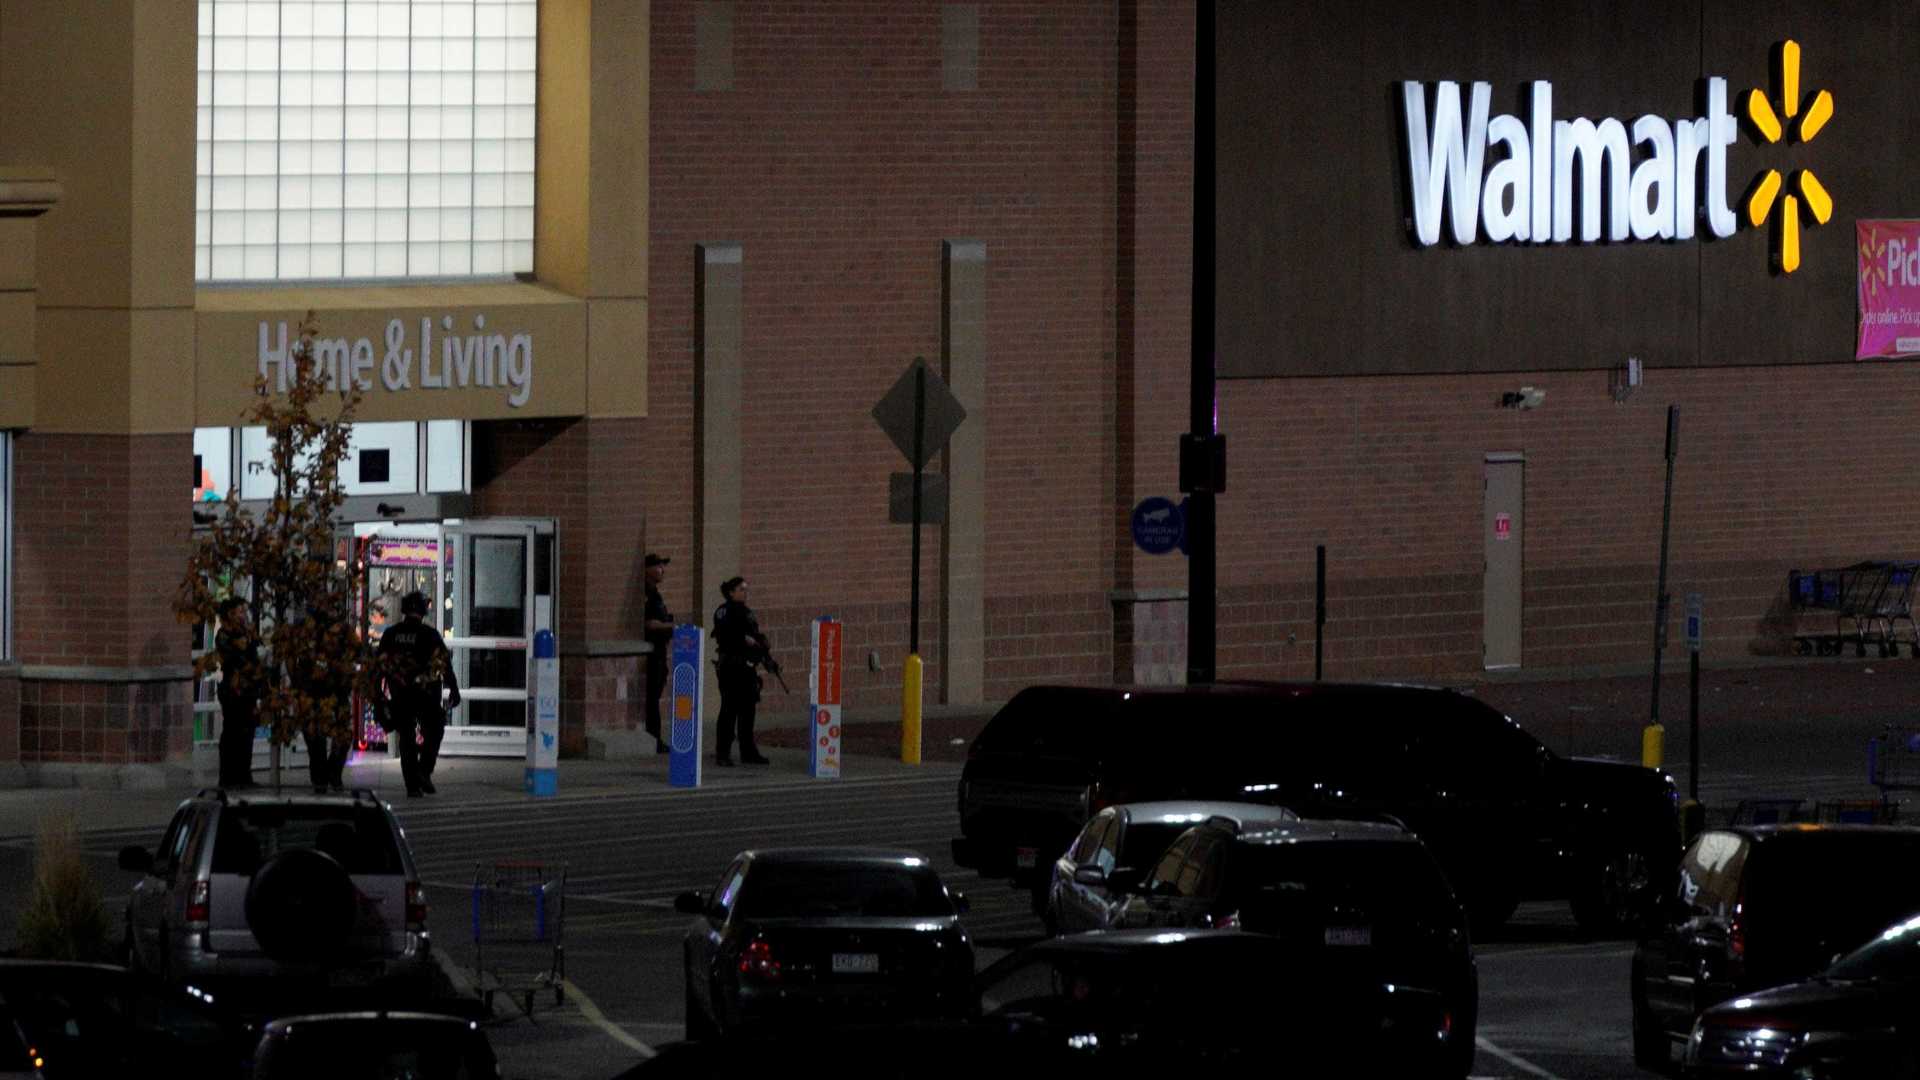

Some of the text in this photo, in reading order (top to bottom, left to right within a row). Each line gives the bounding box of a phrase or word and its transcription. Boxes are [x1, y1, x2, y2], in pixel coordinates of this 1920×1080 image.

[1399, 75, 1738, 247] Walmart
[258, 314, 532, 408] Home & Living
